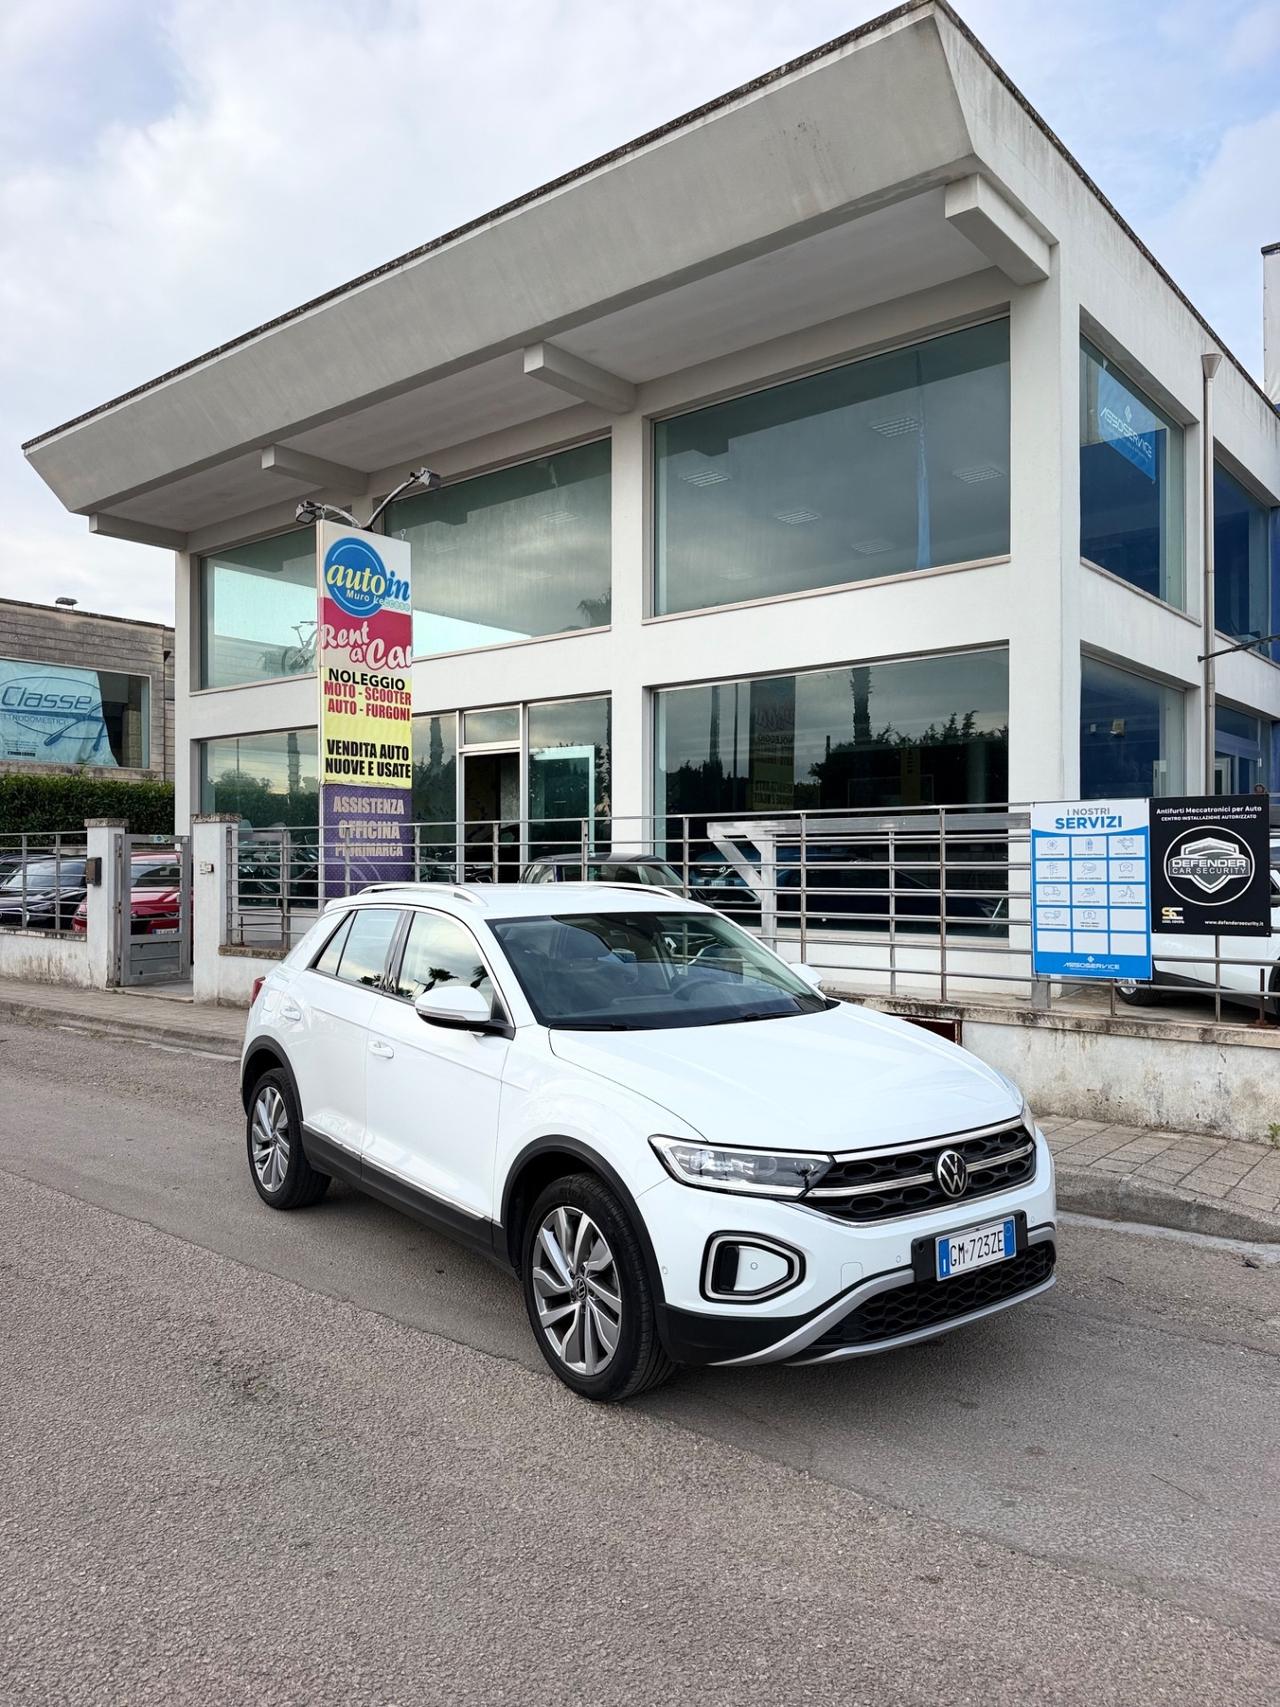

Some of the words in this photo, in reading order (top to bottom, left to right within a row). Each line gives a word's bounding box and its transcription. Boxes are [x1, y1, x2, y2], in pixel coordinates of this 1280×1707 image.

[346, 590, 370, 602] Muro
[320, 620, 370, 648] Rent
[328, 668, 405, 691] NOLEGGIO
[1, 686, 92, 710] Classe
[324, 681, 356, 698] MOTO
[364, 687, 412, 706] SCOOTER
[327, 698, 357, 715] AUTO
[365, 703, 411, 721] FURGONI
[326, 739, 377, 758] VENDITA
[379, 744, 409, 761] AUTO
[325, 758, 365, 775] NUOVE
[368, 761, 374, 776] E
[377, 762, 411, 778] USATE
[333, 796, 404, 815] ASSISTENZA
[1072, 807, 1110, 816] NOSTRI
[338, 819, 400, 839] OFFICINA
[1055, 815, 1122, 829] SERVIZI
[1172, 859, 1246, 867] DEFENDER
